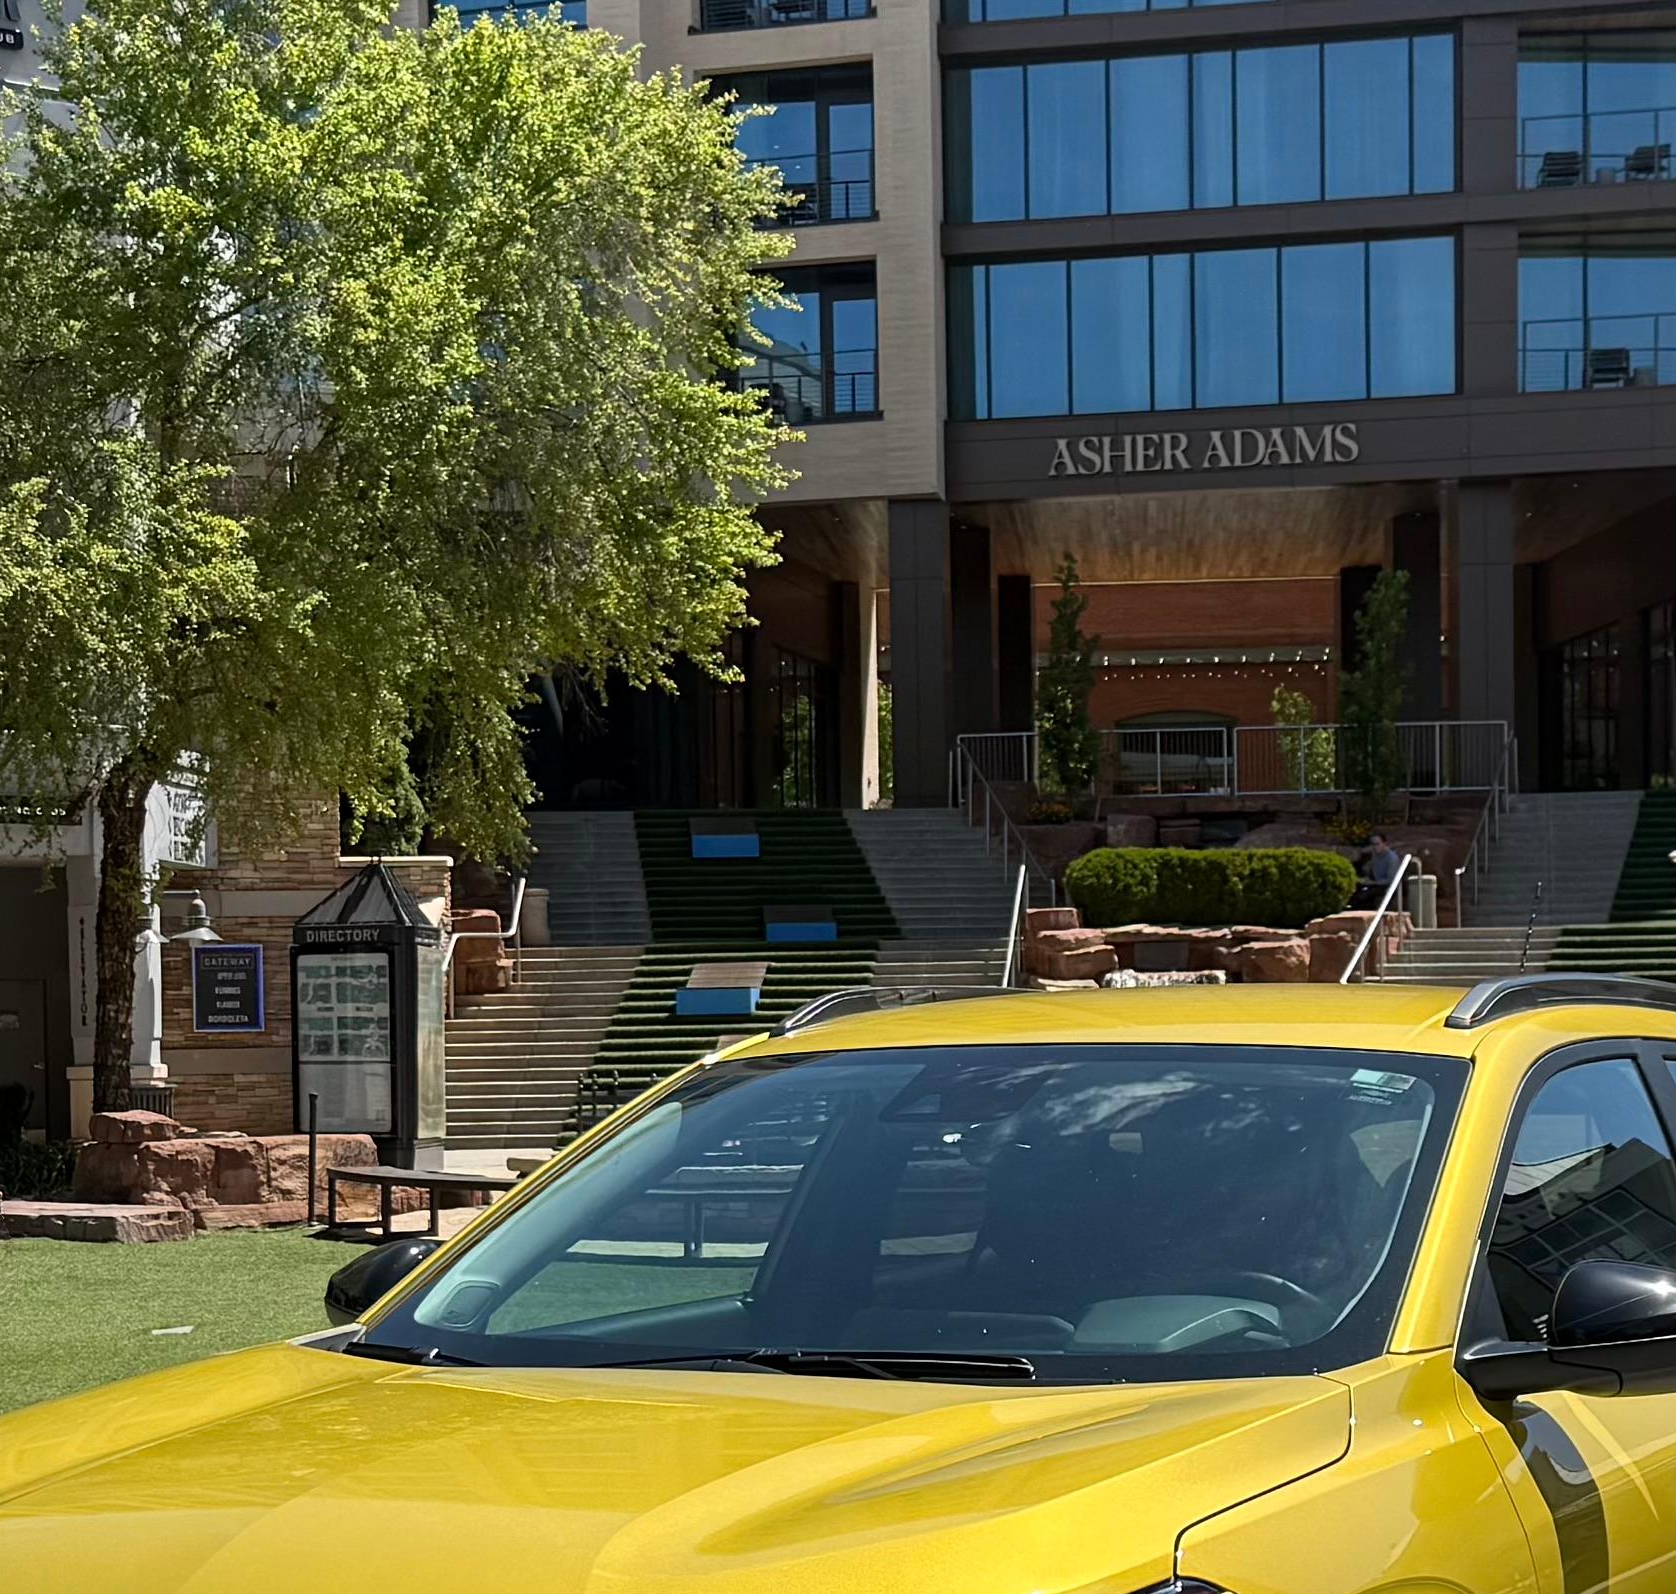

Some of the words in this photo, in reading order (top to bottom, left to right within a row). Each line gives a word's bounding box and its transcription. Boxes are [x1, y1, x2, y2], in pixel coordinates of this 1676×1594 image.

[1049, 433, 1191, 476] ASHER
[1202, 423, 1359, 468] ADAMS
[306, 929, 379, 942] DIRECTORY
